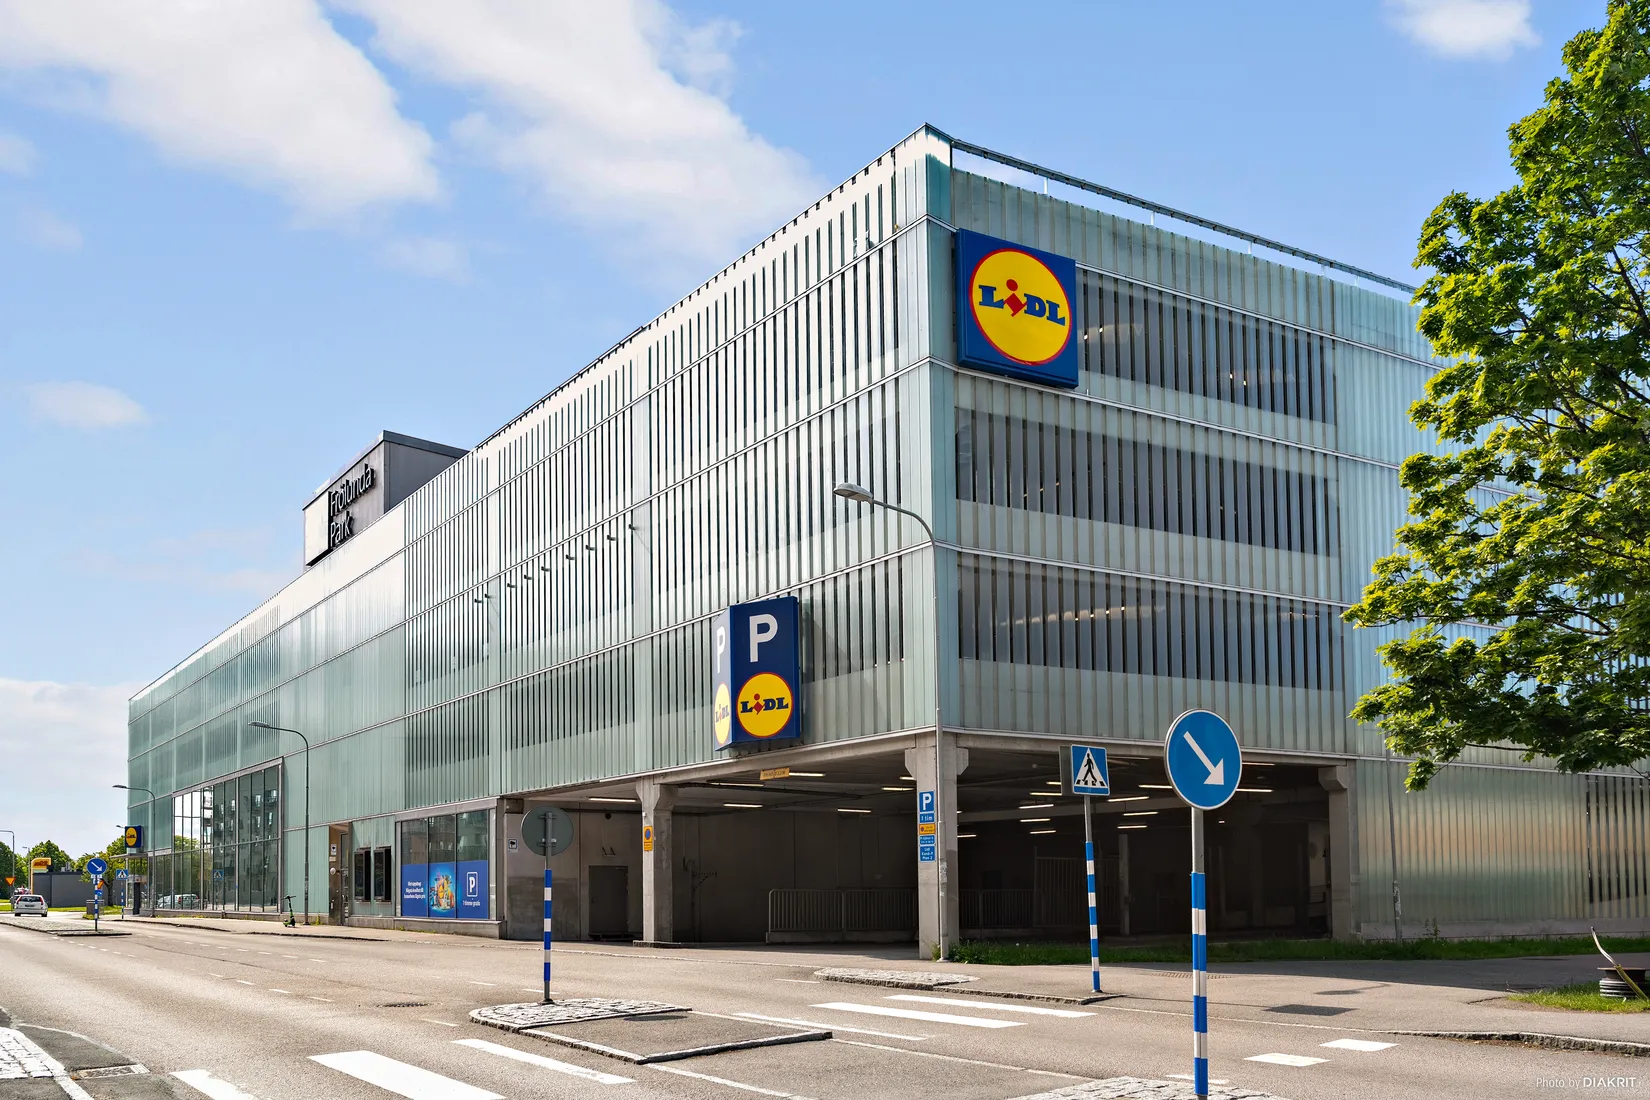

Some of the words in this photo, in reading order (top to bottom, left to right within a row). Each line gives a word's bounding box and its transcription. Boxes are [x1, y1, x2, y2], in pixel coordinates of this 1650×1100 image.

[329, 463, 375, 516] Frölunda
[330, 511, 354, 547] Park
[716, 626, 725, 674] P
[749, 613, 779, 663] P
[922, 792, 932, 811] P
[469, 876, 476, 893] P
